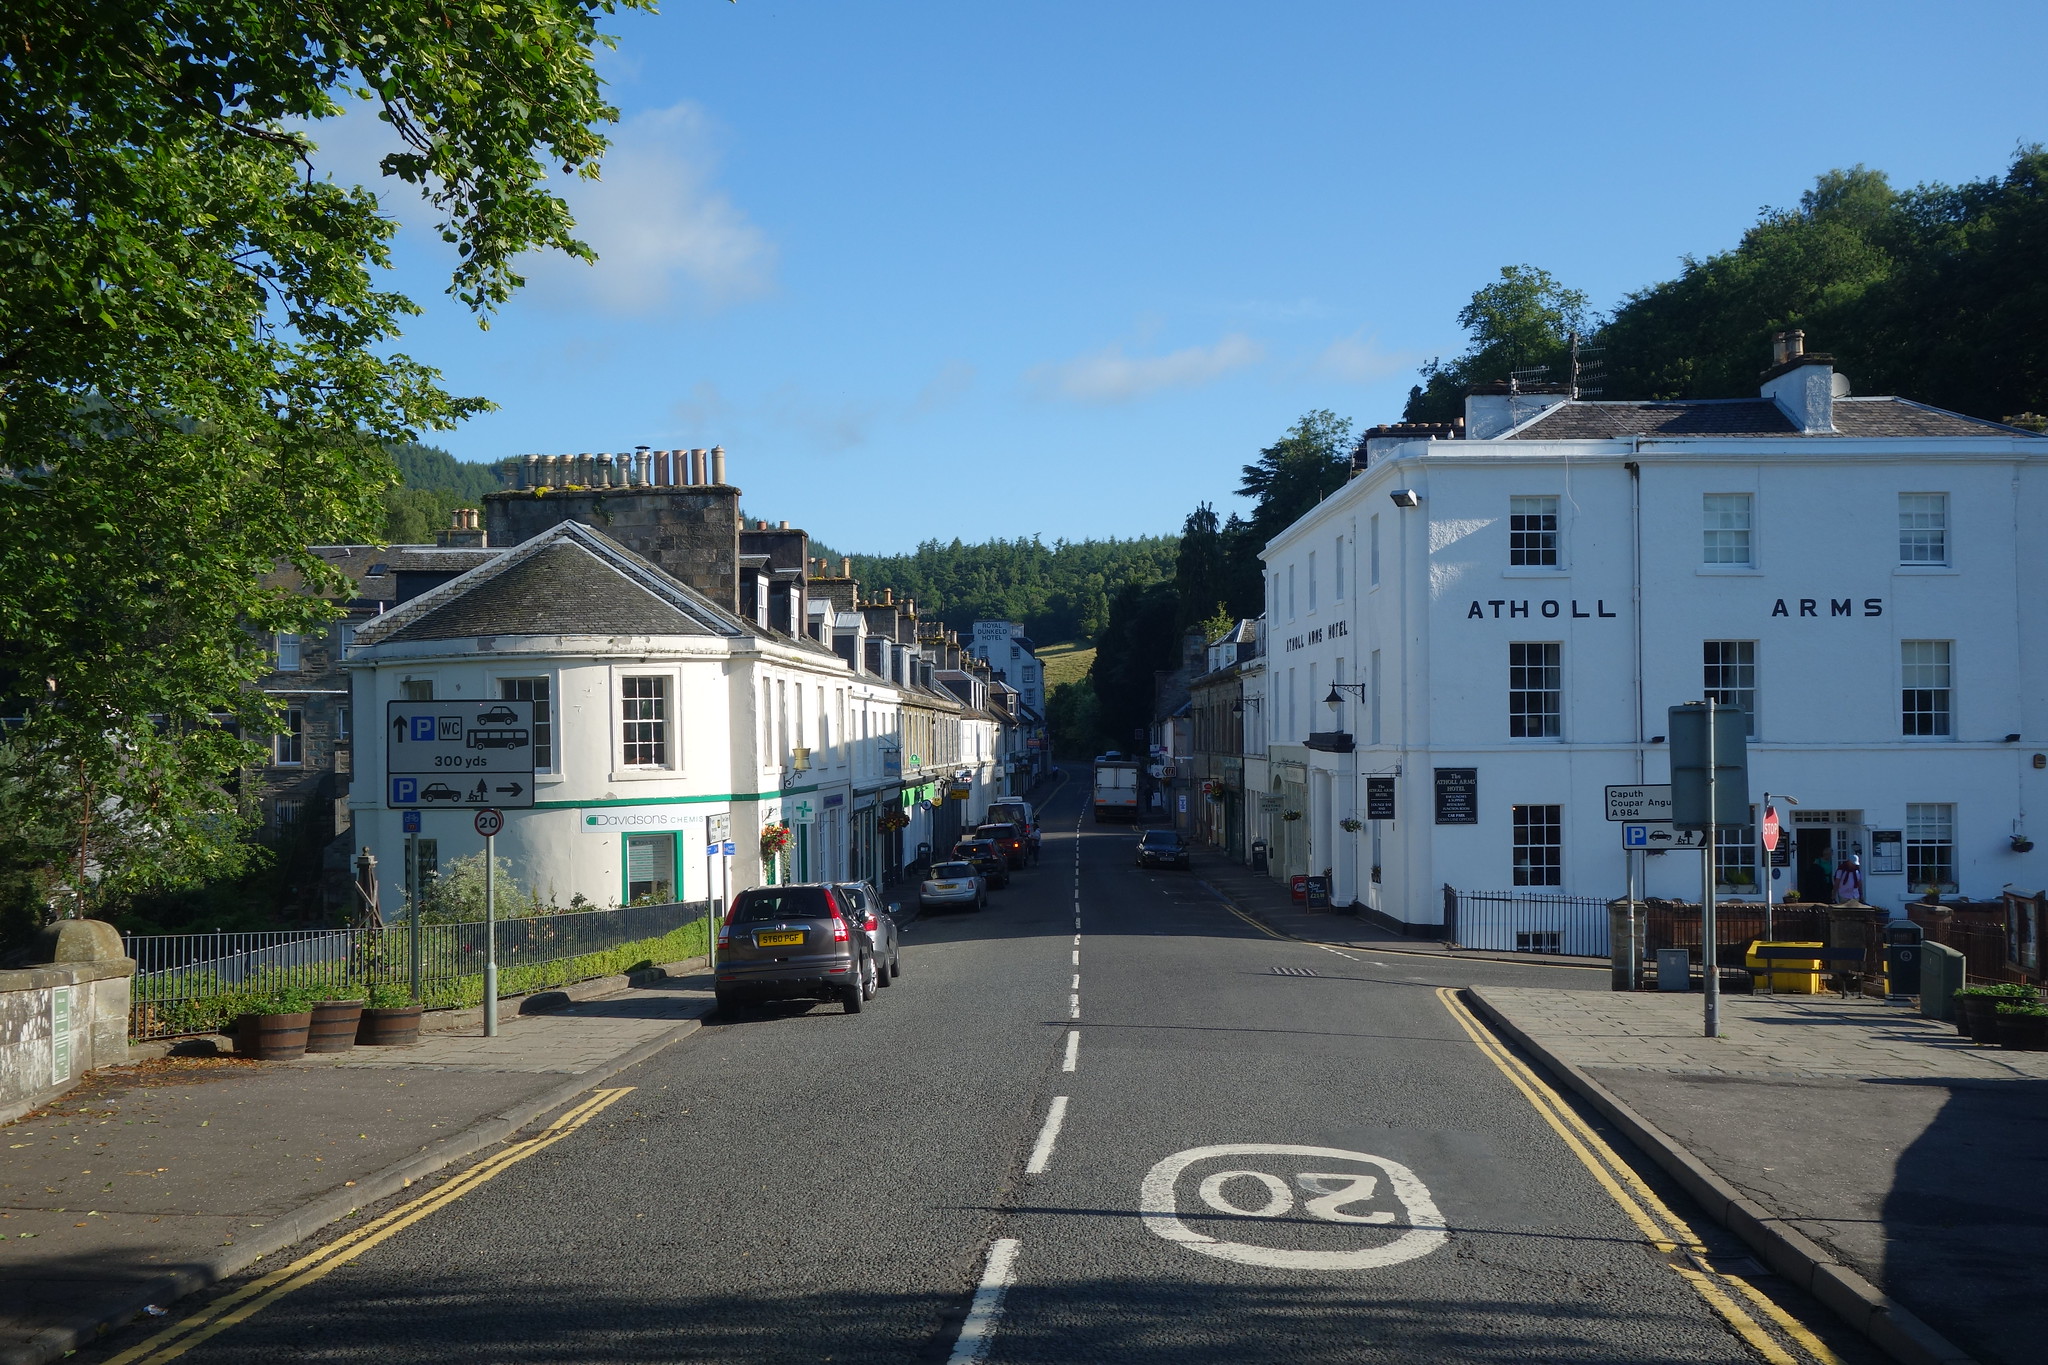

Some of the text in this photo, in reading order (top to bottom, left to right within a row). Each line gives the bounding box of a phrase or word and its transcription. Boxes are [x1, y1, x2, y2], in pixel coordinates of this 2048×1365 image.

[1467, 598, 1883, 619] ATHOLL ARMS
[1286, 620, 1348, 652] ATHOLL ARMS HOTEL
[416, 719, 460, 739] P WC
[434, 755, 487, 768] 300 yds
[399, 781, 414, 801] P
[1610, 790, 1644, 799] Caputh
[1610, 799, 1672, 808] Coupar Angu
[478, 817, 498, 829] 20
[597, 813, 704, 826] Davidsons CHEMIS
[1764, 822, 1778, 836] STOP
[1630, 828, 1645, 845] P
[762, 933, 800, 944] ST60 PGF
[1199, 1170, 1396, 1224] 20
